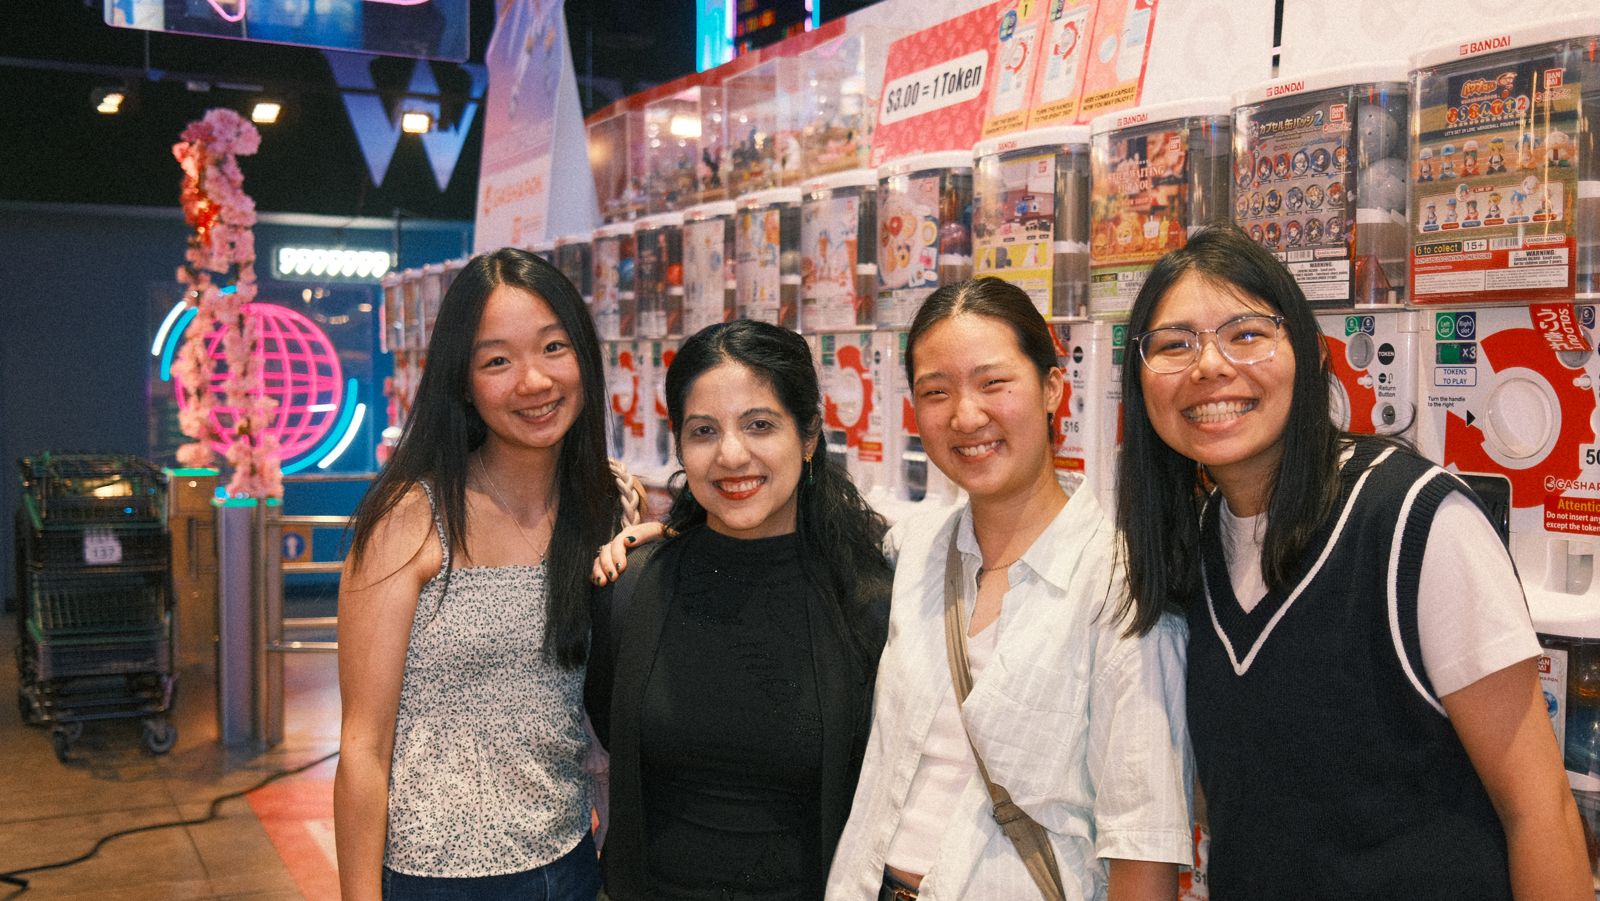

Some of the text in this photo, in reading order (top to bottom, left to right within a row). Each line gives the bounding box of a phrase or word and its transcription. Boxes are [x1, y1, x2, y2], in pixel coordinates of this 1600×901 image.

[1470, 35, 1511, 53] BANDAI
[886, 81, 920, 114] $3.00
[941, 65, 982, 96] Token
[1274, 81, 1305, 95] BANDAI
[1124, 113, 1148, 126] BANDAI
[1417, 247, 1422, 255] 6
[1434, 243, 1458, 253] collect
[1466, 241, 1484, 250] 15+
[1526, 249, 1555, 257] WARNING
[1460, 320, 1472, 328] Right
[1558, 308, 1586, 350] SOLD OUT
[1462, 345, 1477, 359] x3
[1546, 511, 1556, 519] Do
[1569, 513, 1589, 521] insert
[1546, 522, 1568, 531] except
[1569, 522, 1580, 531] the
